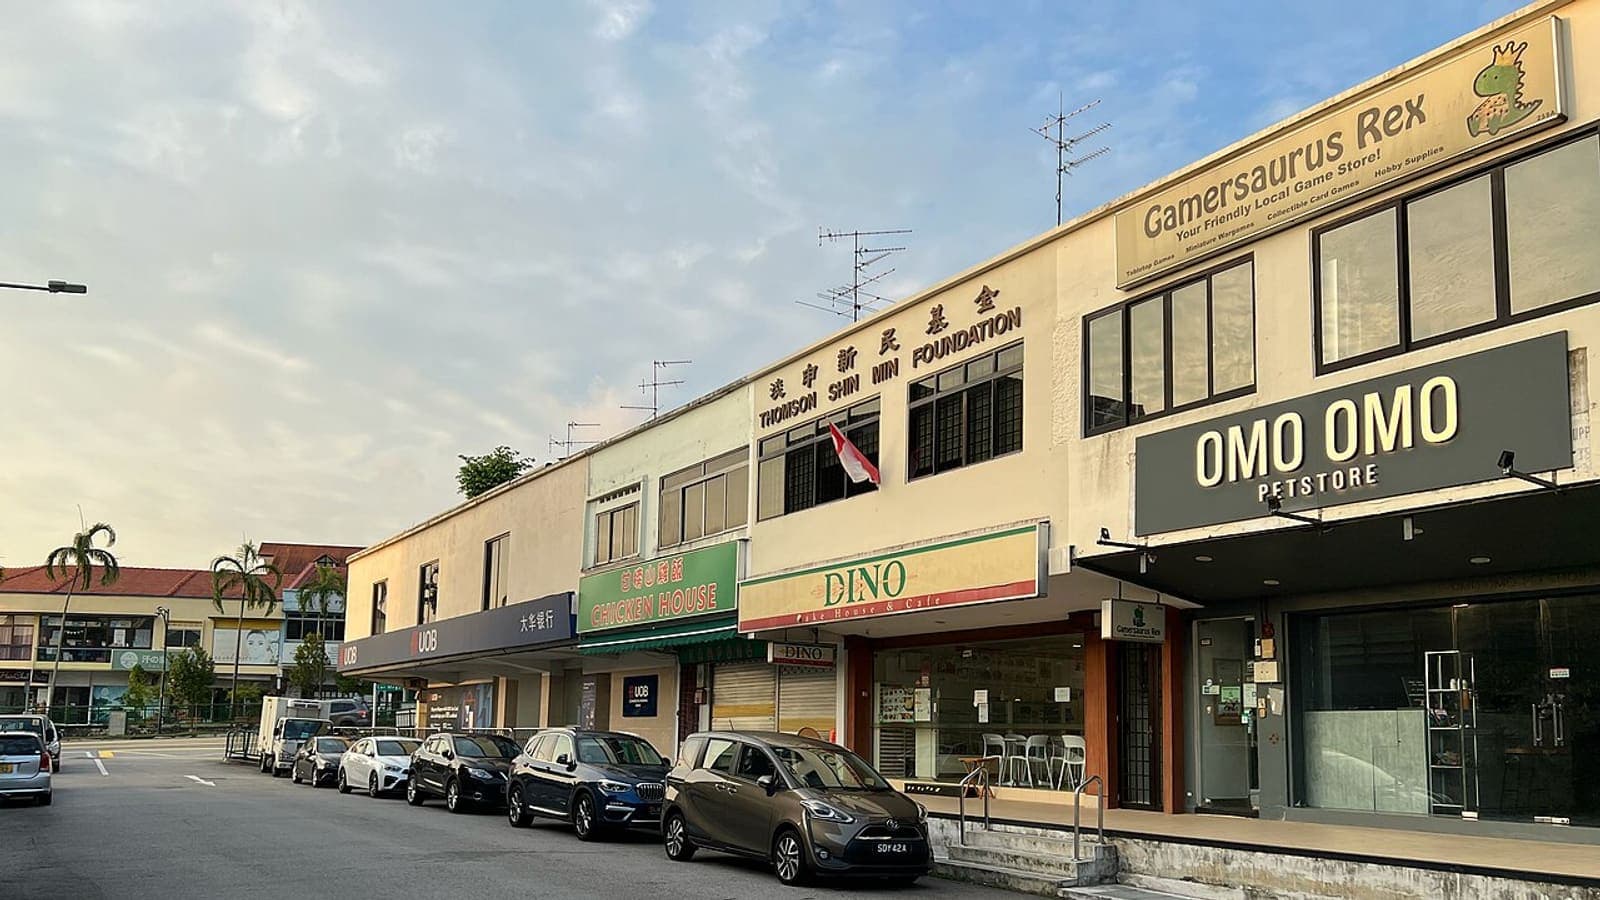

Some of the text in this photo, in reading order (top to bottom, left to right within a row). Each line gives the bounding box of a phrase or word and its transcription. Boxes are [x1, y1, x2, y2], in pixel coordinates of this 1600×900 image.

[1143, 94, 1427, 238] Gamersaurus Rex
[1374, 145, 1445, 178] Hobby Supplies
[1176, 148, 1381, 242] Your Friendly Local Game Store!
[1267, 179, 1360, 220] Collectible Card Games
[1185, 222, 1255, 253] Miniature Wargames
[1126, 254, 1175, 277] Tabletop Games
[759, 306, 1022, 429] THOMSON SHIN MIN FOUNDATION
[1196, 375, 1459, 488] OMO OMO
[1258, 463, 1379, 502] PETSTORE
[823, 560, 907, 607] DINO
[520, 609, 553, 632] 大华银行
[591, 582, 718, 627] CHICKEN HOUSE
[834, 606, 875, 620] House
[886, 600, 894, 612] &
[905, 595, 941, 609] Cafe
[344, 646, 357, 665] UOB
[418, 629, 438, 653] UOB
[785, 646, 823, 660] DINO
[634, 685, 649, 698] UOB
